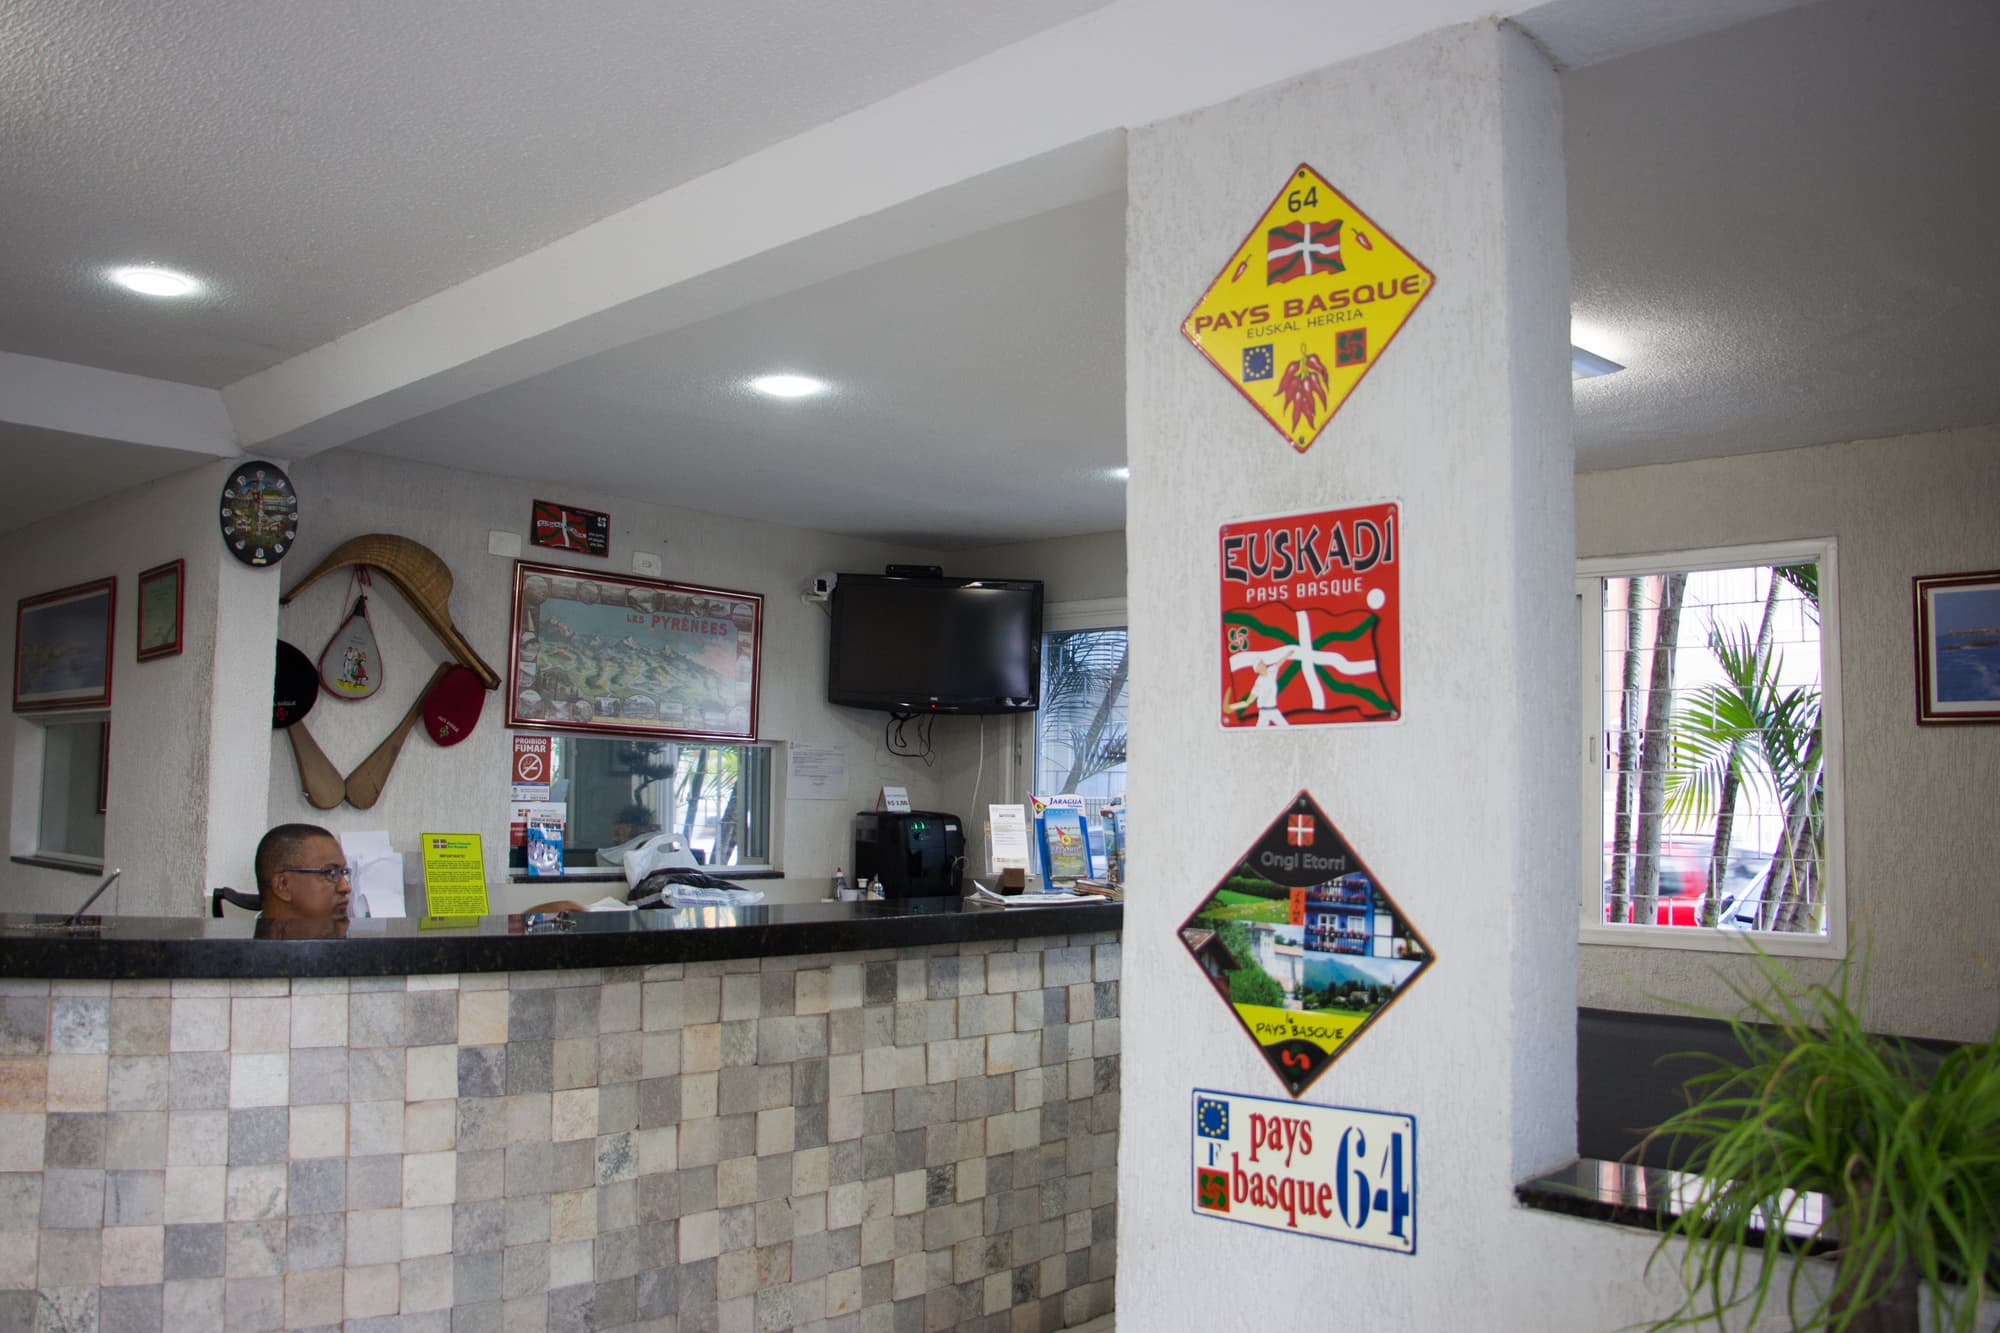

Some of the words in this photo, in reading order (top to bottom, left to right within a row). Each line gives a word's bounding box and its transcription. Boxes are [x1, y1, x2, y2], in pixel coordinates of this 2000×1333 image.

[1288, 187, 1318, 212] 64
[1195, 304, 1270, 334] PAYS
[1283, 274, 1420, 319] BASQUE
[1246, 321, 1300, 339] EUSKAL
[1307, 308, 1364, 328] HERRIA
[1223, 514, 1393, 584] EUSKADI
[1246, 584, 1288, 602] PAYS
[1296, 577, 1363, 598] BASQUE
[515, 744, 546, 752] FUMAR
[1260, 851, 1299, 871] Ongi
[1302, 853, 1345, 871] Etorri
[1256, 1022, 1287, 1036] PAYS
[1291, 1025, 1344, 1039] BASQUE
[1249, 1112, 1313, 1168] pays
[1231, 1152, 1333, 1228] basque
[1335, 1125, 1410, 1238] 64
